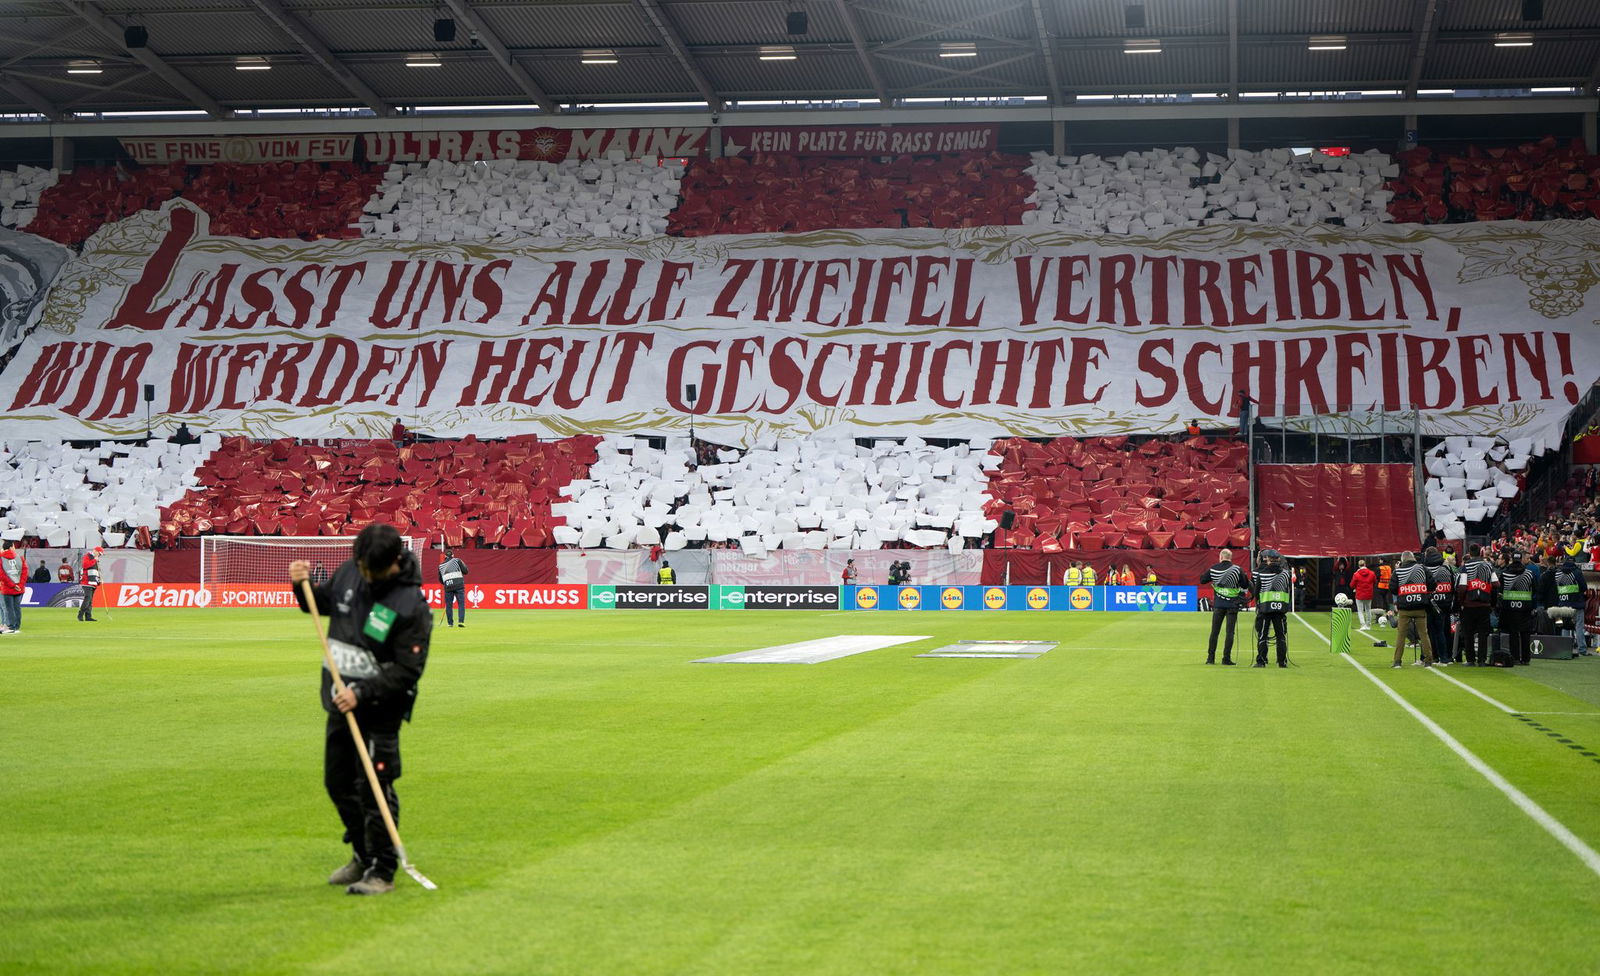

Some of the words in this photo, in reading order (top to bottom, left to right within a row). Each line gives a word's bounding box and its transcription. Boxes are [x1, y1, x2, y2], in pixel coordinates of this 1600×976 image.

[258, 139, 300, 157] VOM
[308, 139, 350, 156] FSV
[363, 130, 521, 162] ULTRAS
[565, 127, 708, 160] MAINZ
[750, 131, 791, 151] KEIN
[799, 131, 847, 151] PLATZ
[854, 130, 888, 152] FÜR
[891, 130, 933, 153] RASS
[936, 128, 991, 151] ISMUS
[123, 142, 156, 159] DIE
[165, 142, 221, 159] FANS
[104, 207, 364, 331] LASST
[368, 259, 512, 329] UNS
[518, 258, 694, 326] ALLE
[707, 256, 982, 327] ZWEIFEL
[1015, 248, 1461, 332] VERTREIBEN,
[4, 342, 152, 421] WIR
[157, 338, 455, 414] WERDEN
[456, 332, 655, 408] HEUT
[666, 337, 1111, 415] GESCHICHTE
[1135, 331, 1580, 418] SCHREIBEN!
[117, 585, 211, 607] Betano
[495, 589, 579, 605] STRAUSS
[598, 589, 707, 606] enterprise
[1399, 584, 1428, 593] PHOTO
[727, 589, 838, 607] enterprise
[1115, 591, 1187, 605] RECYCLE
